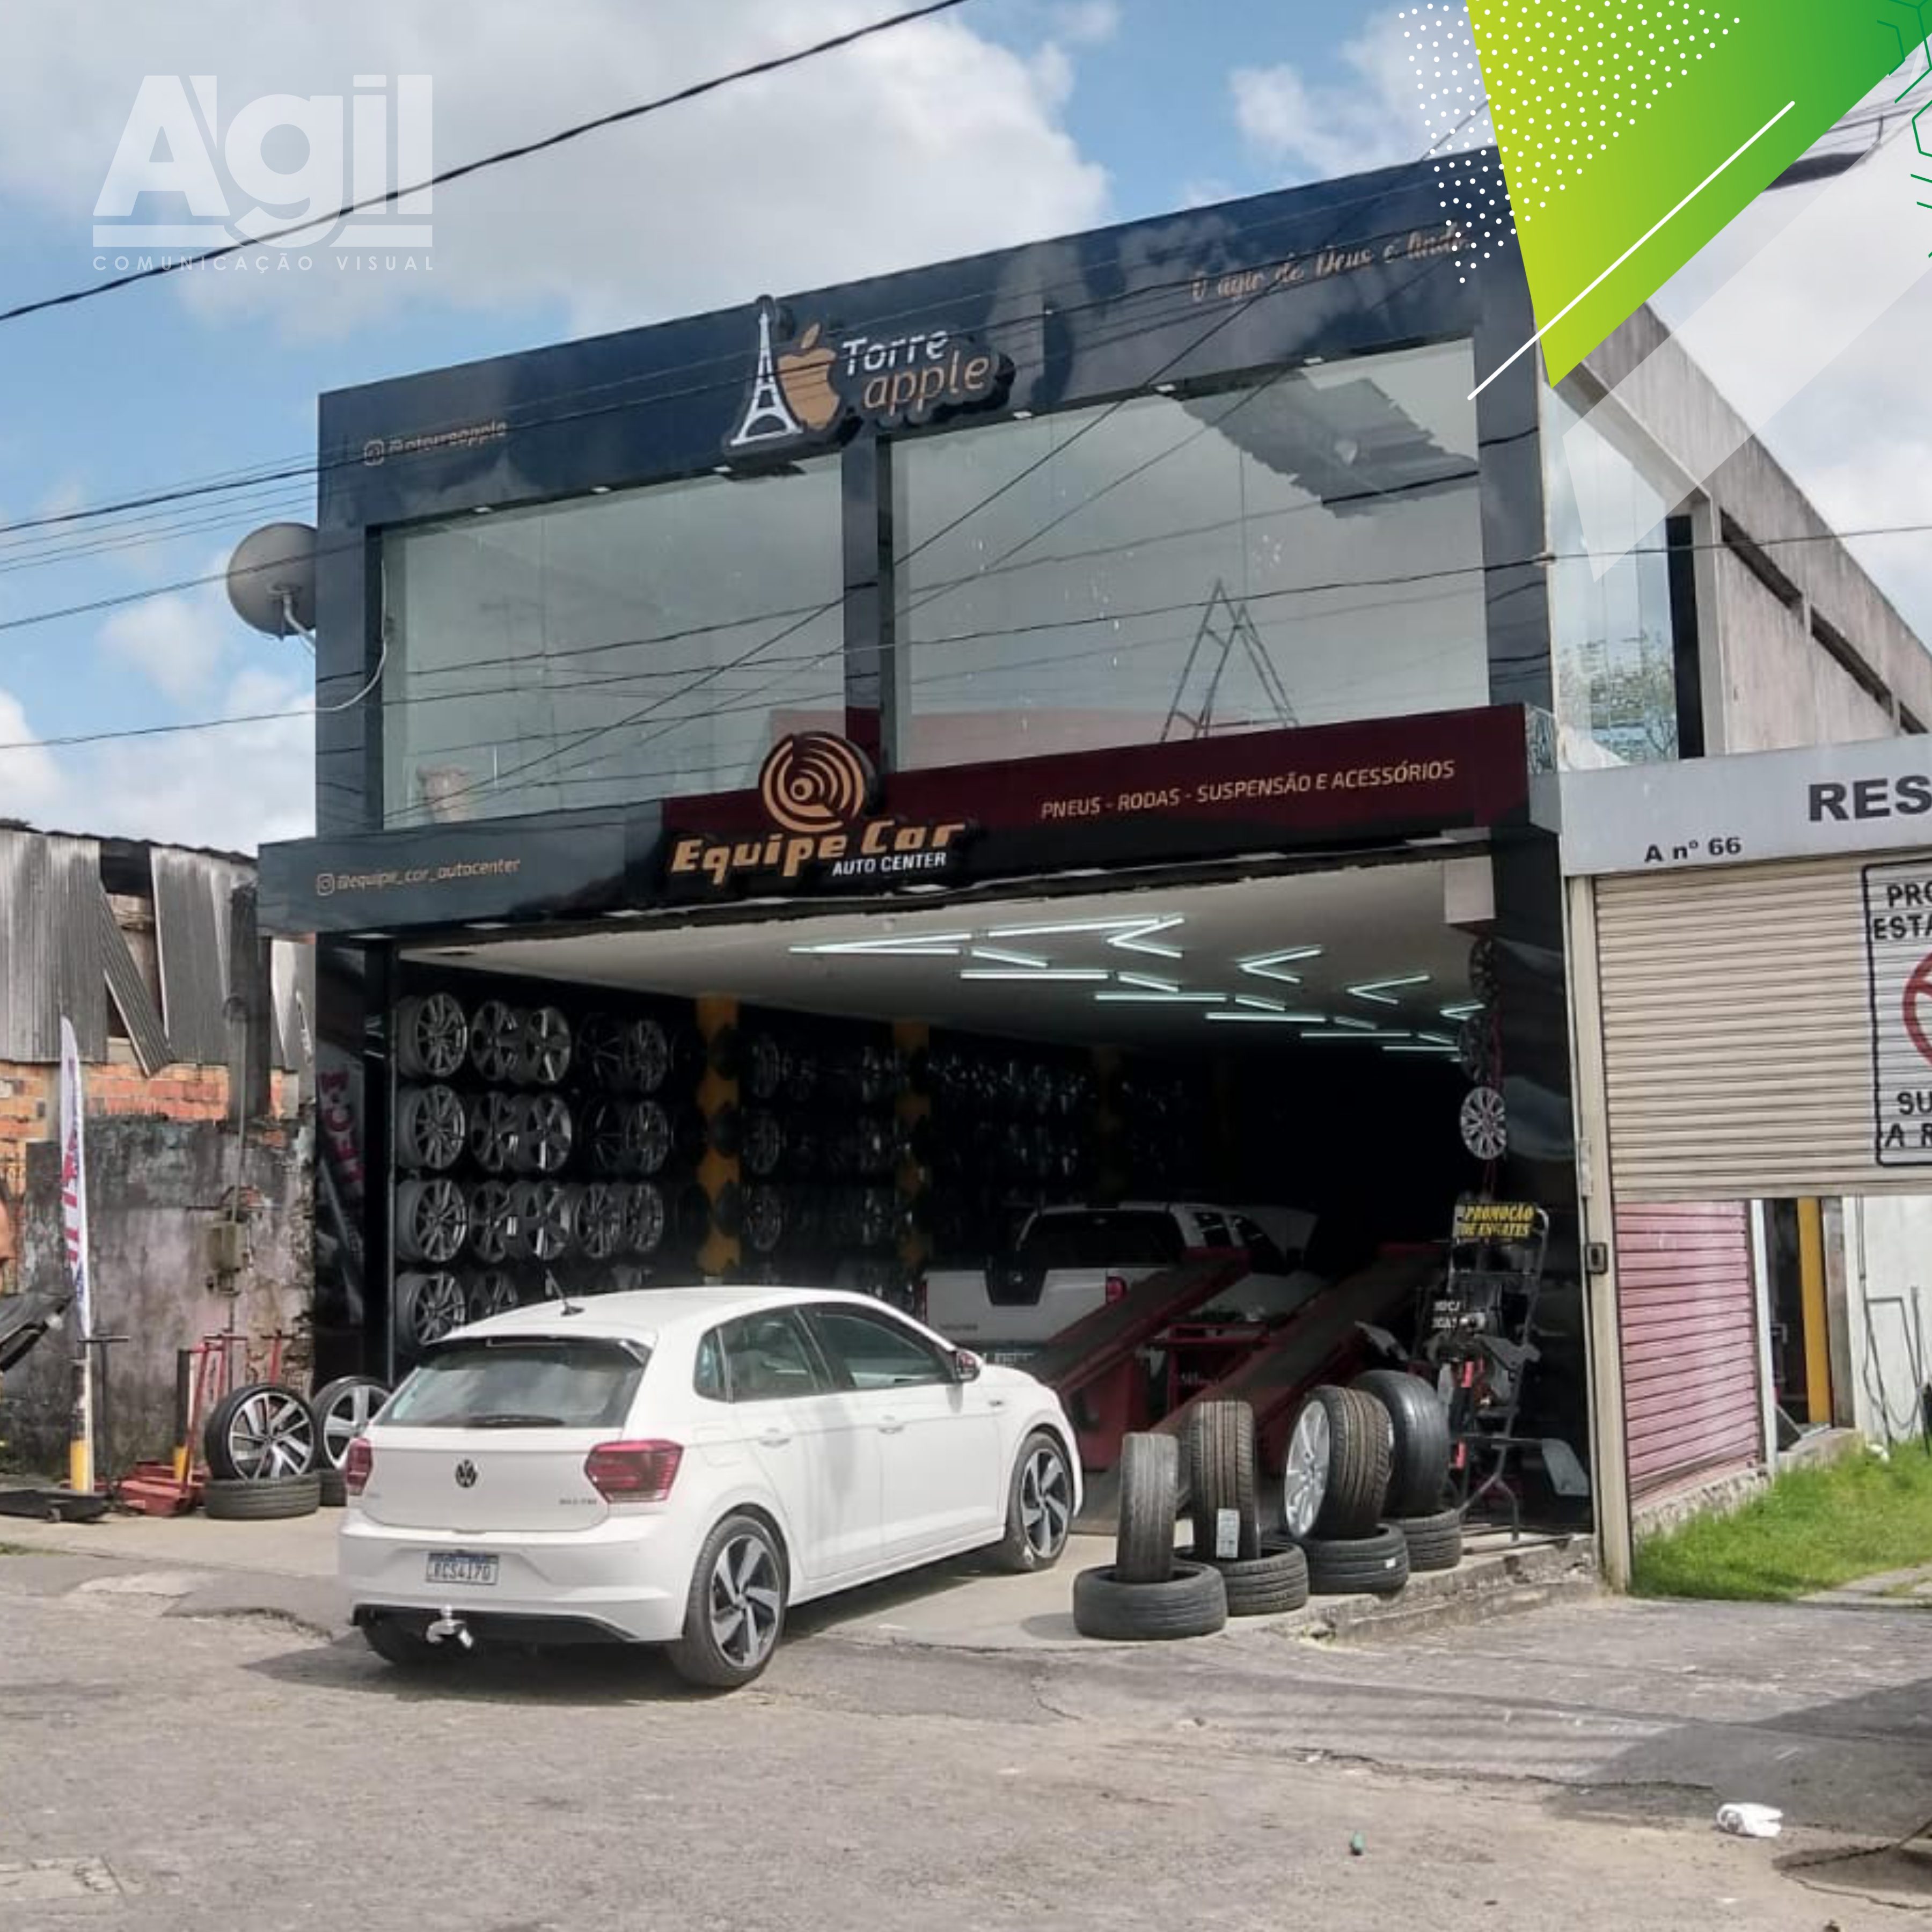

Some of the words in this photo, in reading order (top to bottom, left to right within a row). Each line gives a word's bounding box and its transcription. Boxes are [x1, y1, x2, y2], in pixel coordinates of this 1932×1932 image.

[842, 330, 949, 376] Torre
[865, 350, 989, 415] apple
[1041, 796, 1101, 819] PNEUS
[1117, 788, 1181, 811] RODAS
[1197, 772, 1311, 803] SUSPENSÃO
[1316, 774, 1327, 790] E
[1331, 759, 1455, 788] ACESSÓRIOS
[1808, 774, 1932, 822] RES
[671, 833, 847, 885] Equipe
[861, 820, 965, 854] Car
[832, 860, 877, 877] AUTO
[881, 852, 947, 872] CENTER
[1644, 844, 1663, 862] A
[1708, 837, 1741, 855] 66
[1885, 1123, 1905, 1147] A
